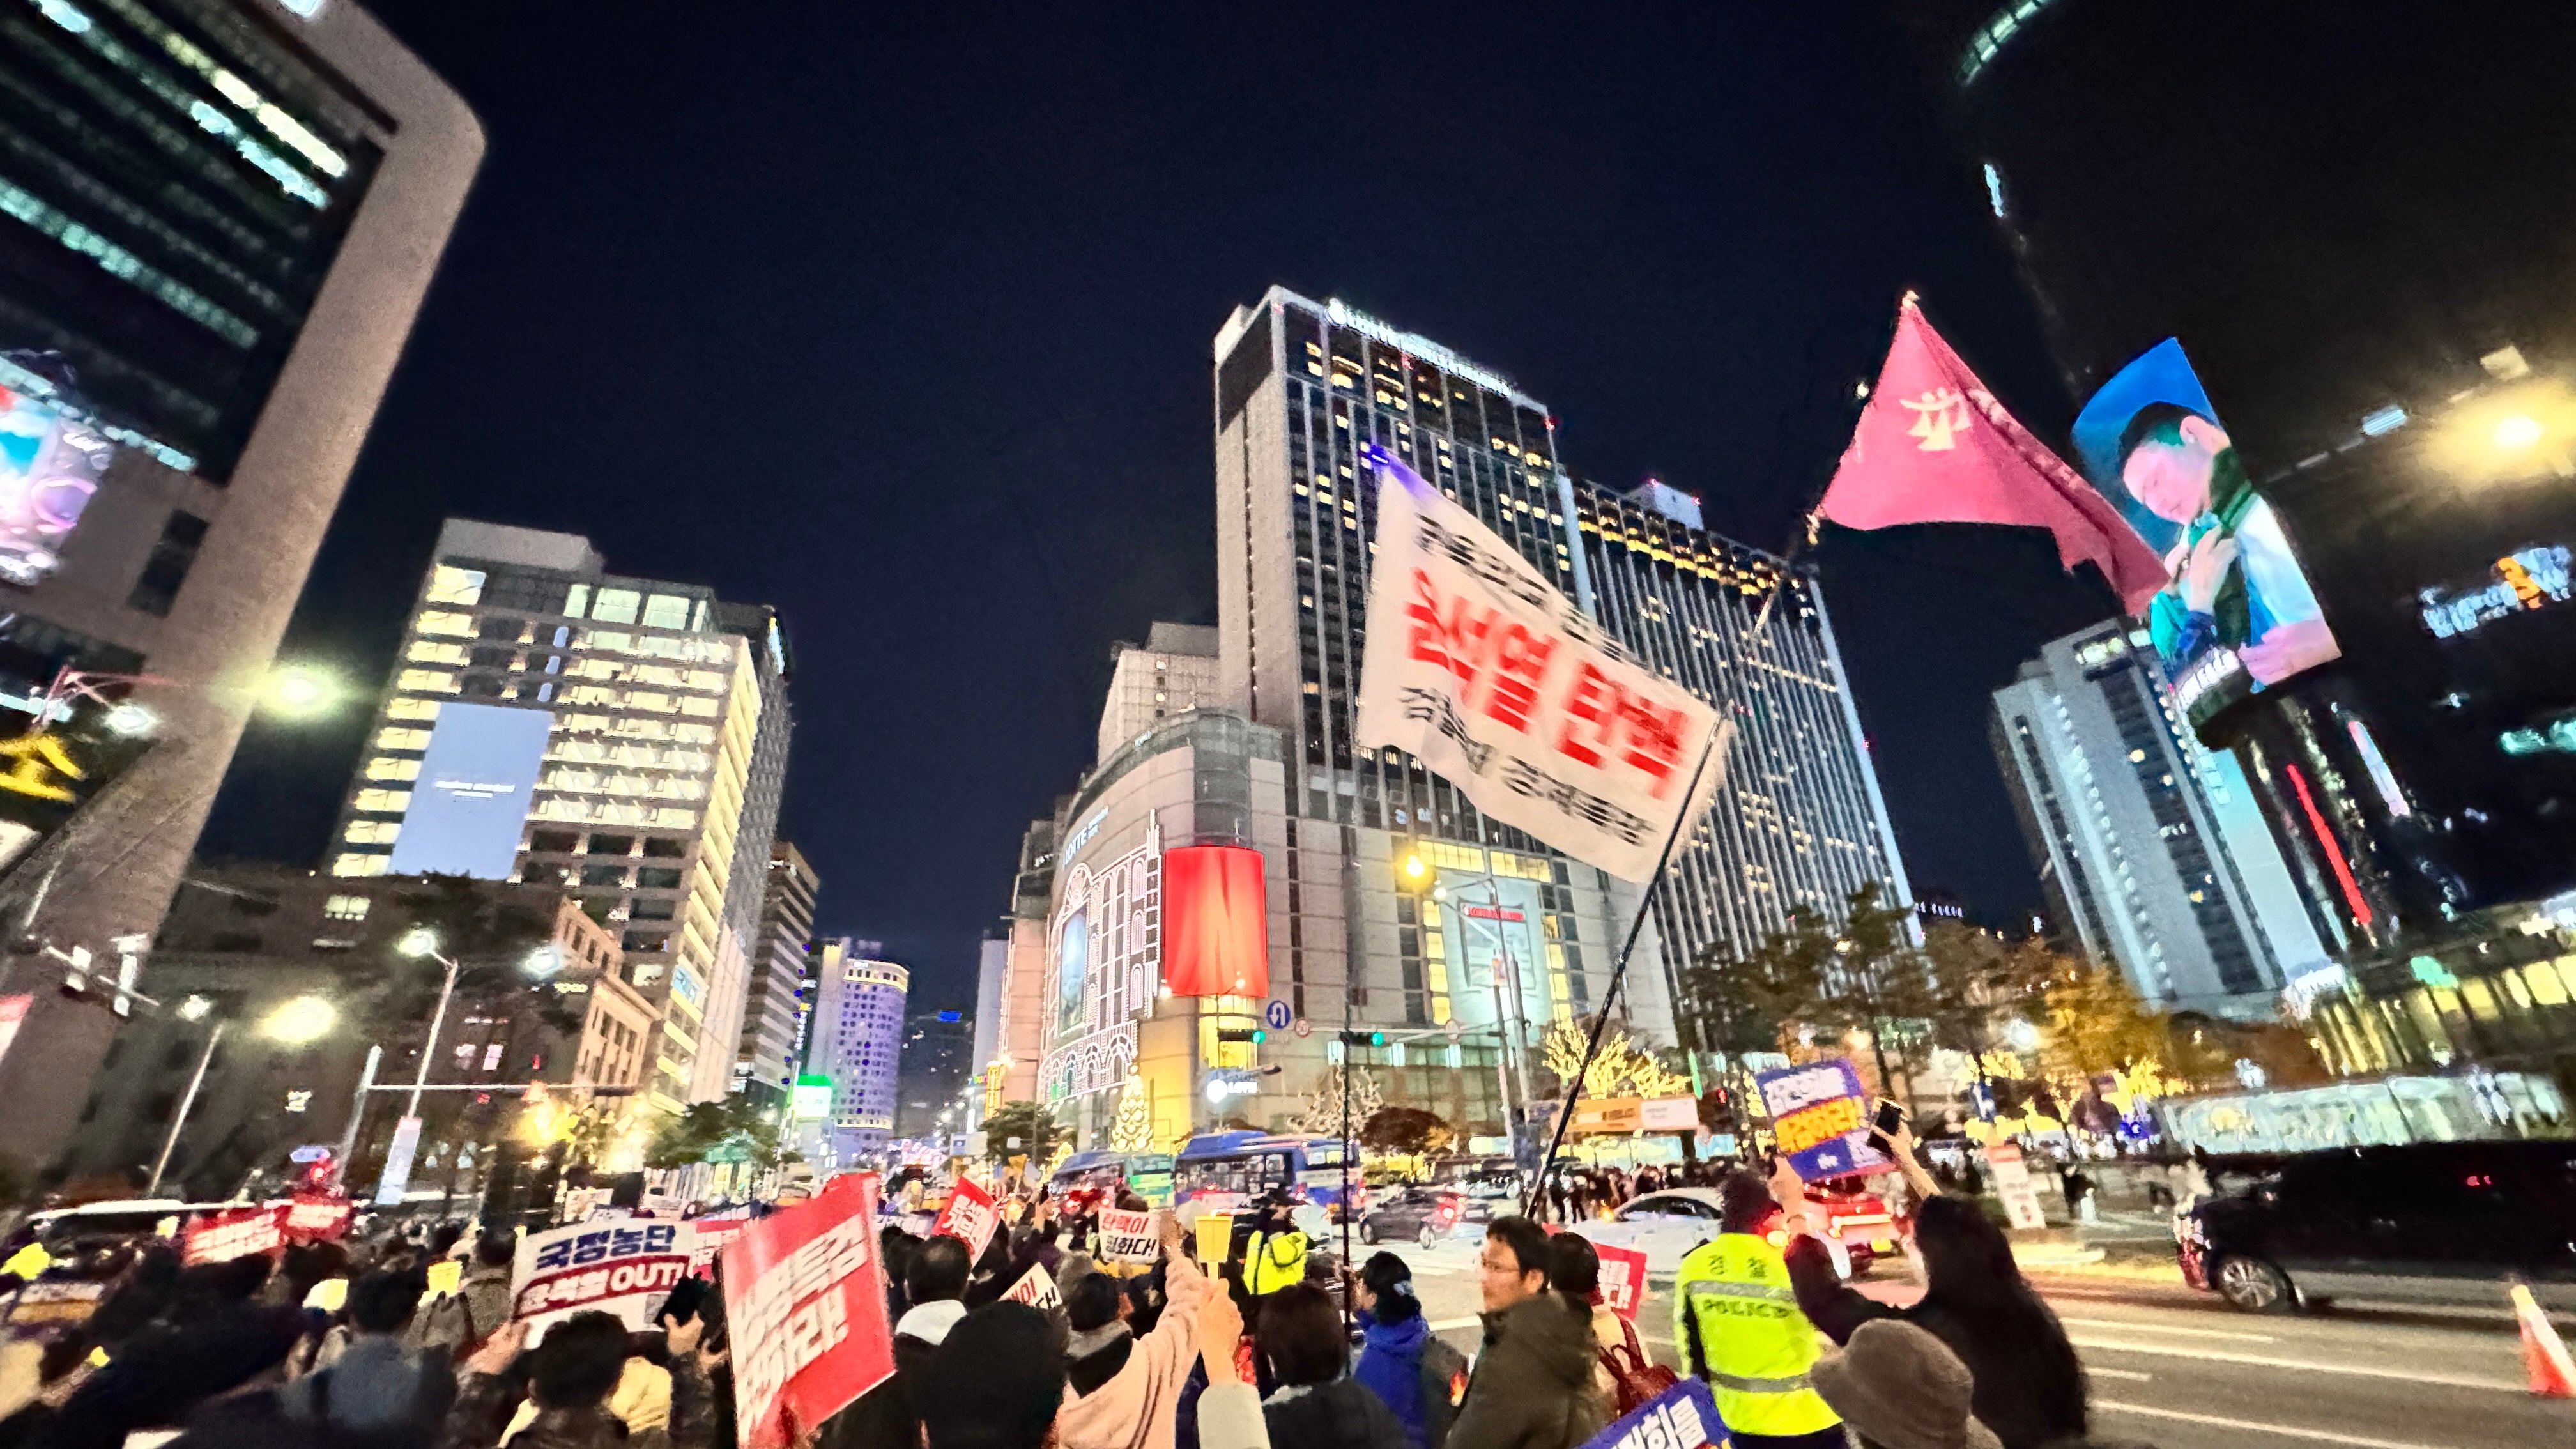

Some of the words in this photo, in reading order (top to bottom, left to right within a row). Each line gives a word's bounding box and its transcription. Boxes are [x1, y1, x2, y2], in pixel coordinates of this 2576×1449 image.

[1404, 567, 1559, 735] 윤석열
[1554, 659, 1689, 800] 탄핵
[1064, 827, 1087, 866] LOTTE
[1101, 1213, 1149, 1234] 탄핵이
[536, 1225, 676, 1271] 국정농단
[611, 1262, 685, 1291] OUT!
[1703, 1298, 1793, 1319] POLICE
